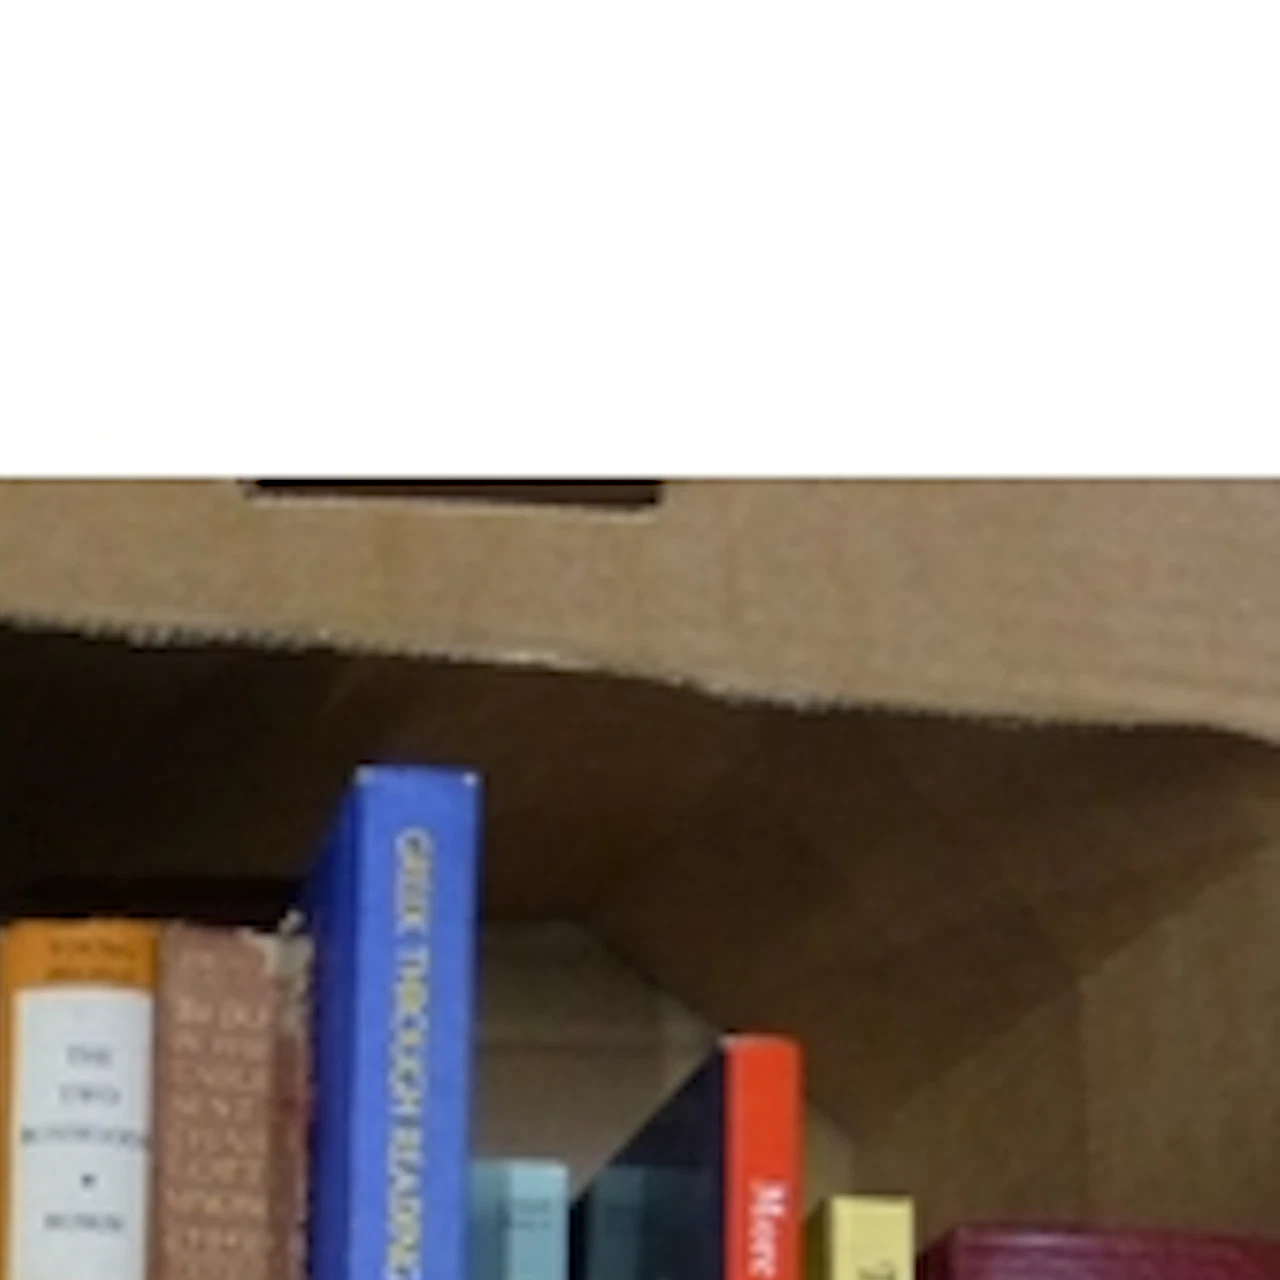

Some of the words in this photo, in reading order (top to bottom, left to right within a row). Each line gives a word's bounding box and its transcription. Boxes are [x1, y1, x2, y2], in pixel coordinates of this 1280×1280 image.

[393, 827, 436, 937] GREEK
[387, 943, 430, 1116] THROUGH
[748, 1180, 789, 1280] More
